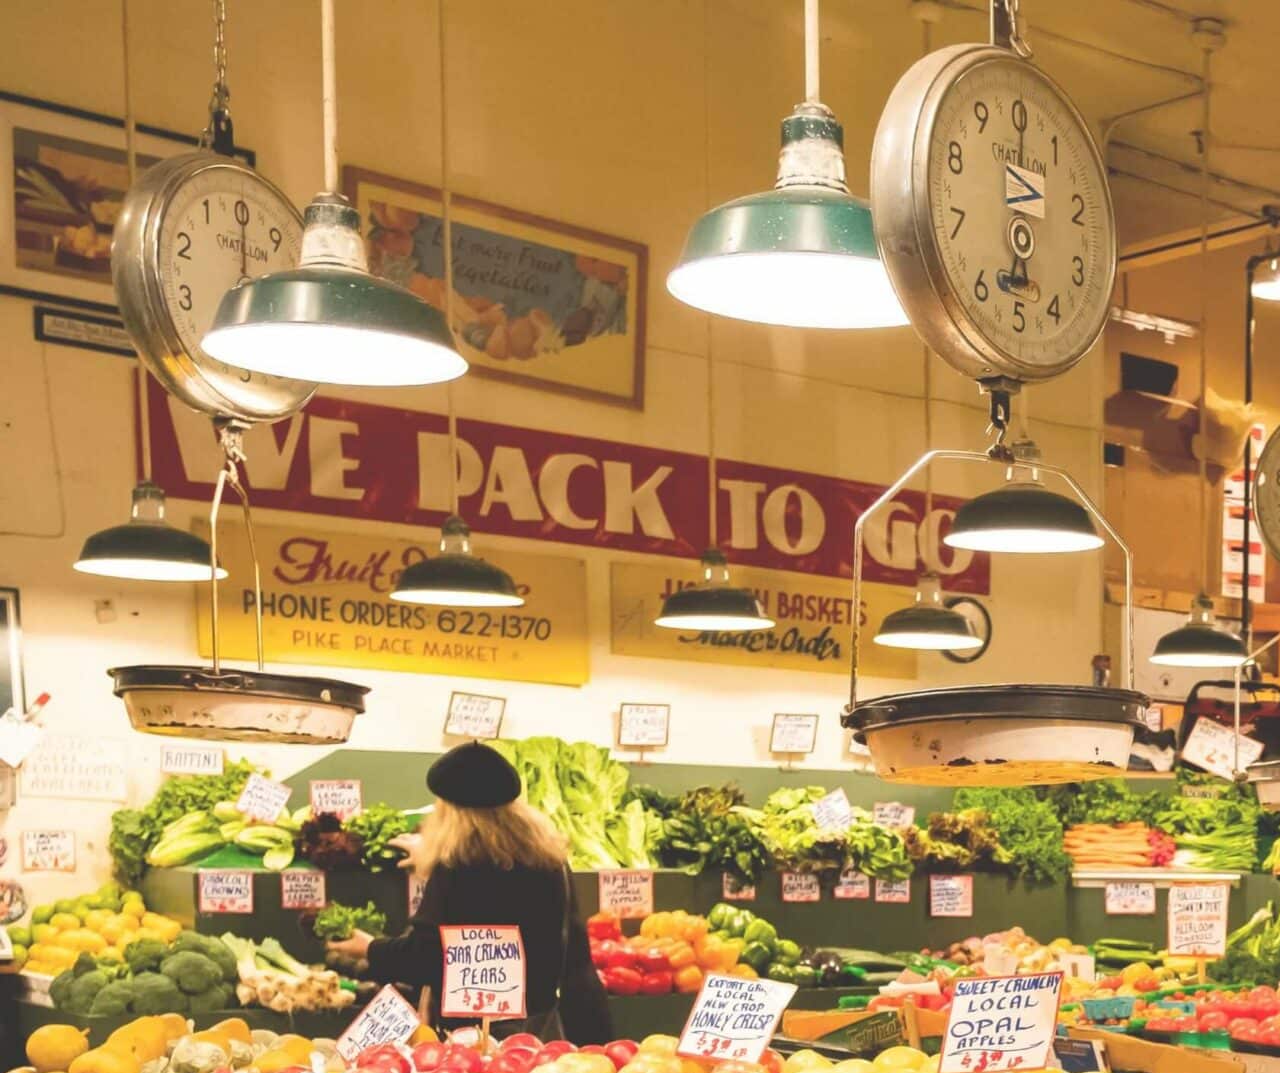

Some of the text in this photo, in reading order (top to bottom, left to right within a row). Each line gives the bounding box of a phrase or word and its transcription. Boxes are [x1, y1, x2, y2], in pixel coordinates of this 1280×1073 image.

[975, 102, 989, 134] 9
[1011, 100, 1028, 133] 0
[948, 141, 963, 175] 8
[991, 142, 1047, 178] CHATILLON
[1050, 135, 1058, 166] 1
[201, 201, 212, 226] 1
[233, 200, 250, 227] 0
[950, 207, 965, 241] 7
[1071, 194, 1085, 226] 2
[176, 232, 192, 261] 2
[268, 227, 283, 253] 9
[975, 269, 988, 302] 6
[1071, 257, 1085, 287] 3
[179, 284, 193, 312] 3
[1046, 294, 1061, 325] 4
[1012, 301, 1025, 333] 5
[164, 393, 975, 576] WE PACK TO GO
[273, 537, 391, 593] Fruit
[243, 588, 334, 623] PHONE
[437, 609, 553, 641] 622-1370
[777, 592, 867, 627] BASKETS
[292, 630, 500, 663] PIKE PLACE MARKET
[461, 928, 503, 941] LOCAL
[447, 942, 521, 965] STAR CRIMSON
[460, 967, 507, 986] PEARS
[708, 977, 744, 991] EXPORT
[704, 1000, 765, 1012] NEW CROP
[716, 990, 756, 1001] LOCAL
[968, 995, 1040, 1013] LOCAL
[691, 1011, 775, 1031] HONEY CRISP
[951, 1016, 1036, 1038] OPAL
[957, 1034, 1017, 1049] APPLES
